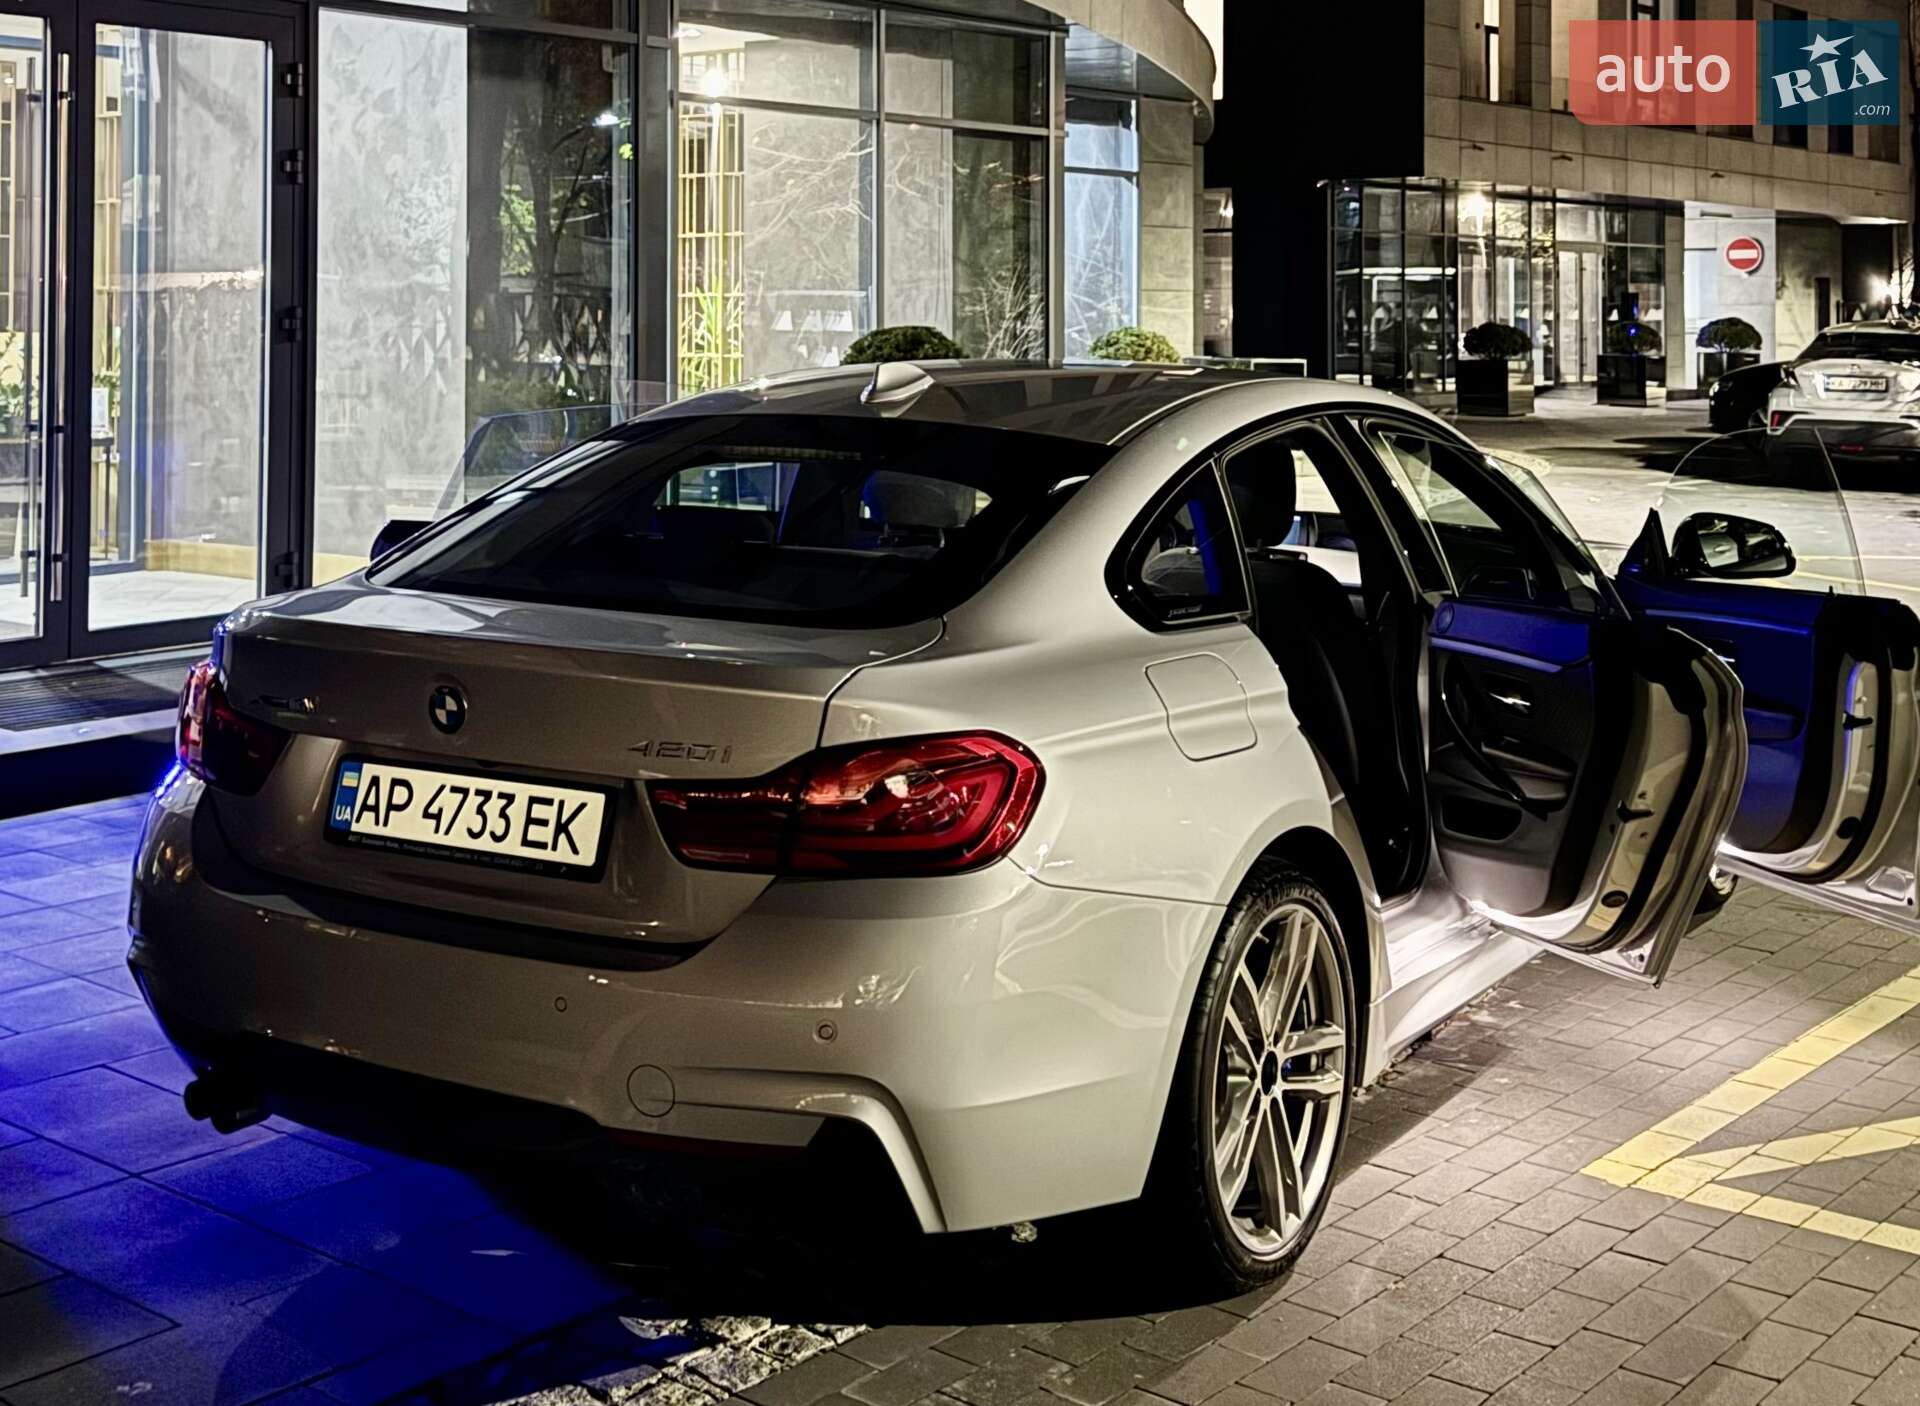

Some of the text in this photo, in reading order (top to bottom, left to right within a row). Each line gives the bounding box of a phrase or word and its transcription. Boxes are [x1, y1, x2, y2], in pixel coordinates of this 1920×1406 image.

[335, 805, 351, 821] UA
[354, 775, 414, 828] AP
[421, 784, 516, 843] 4733
[520, 795, 588, 856] EK
